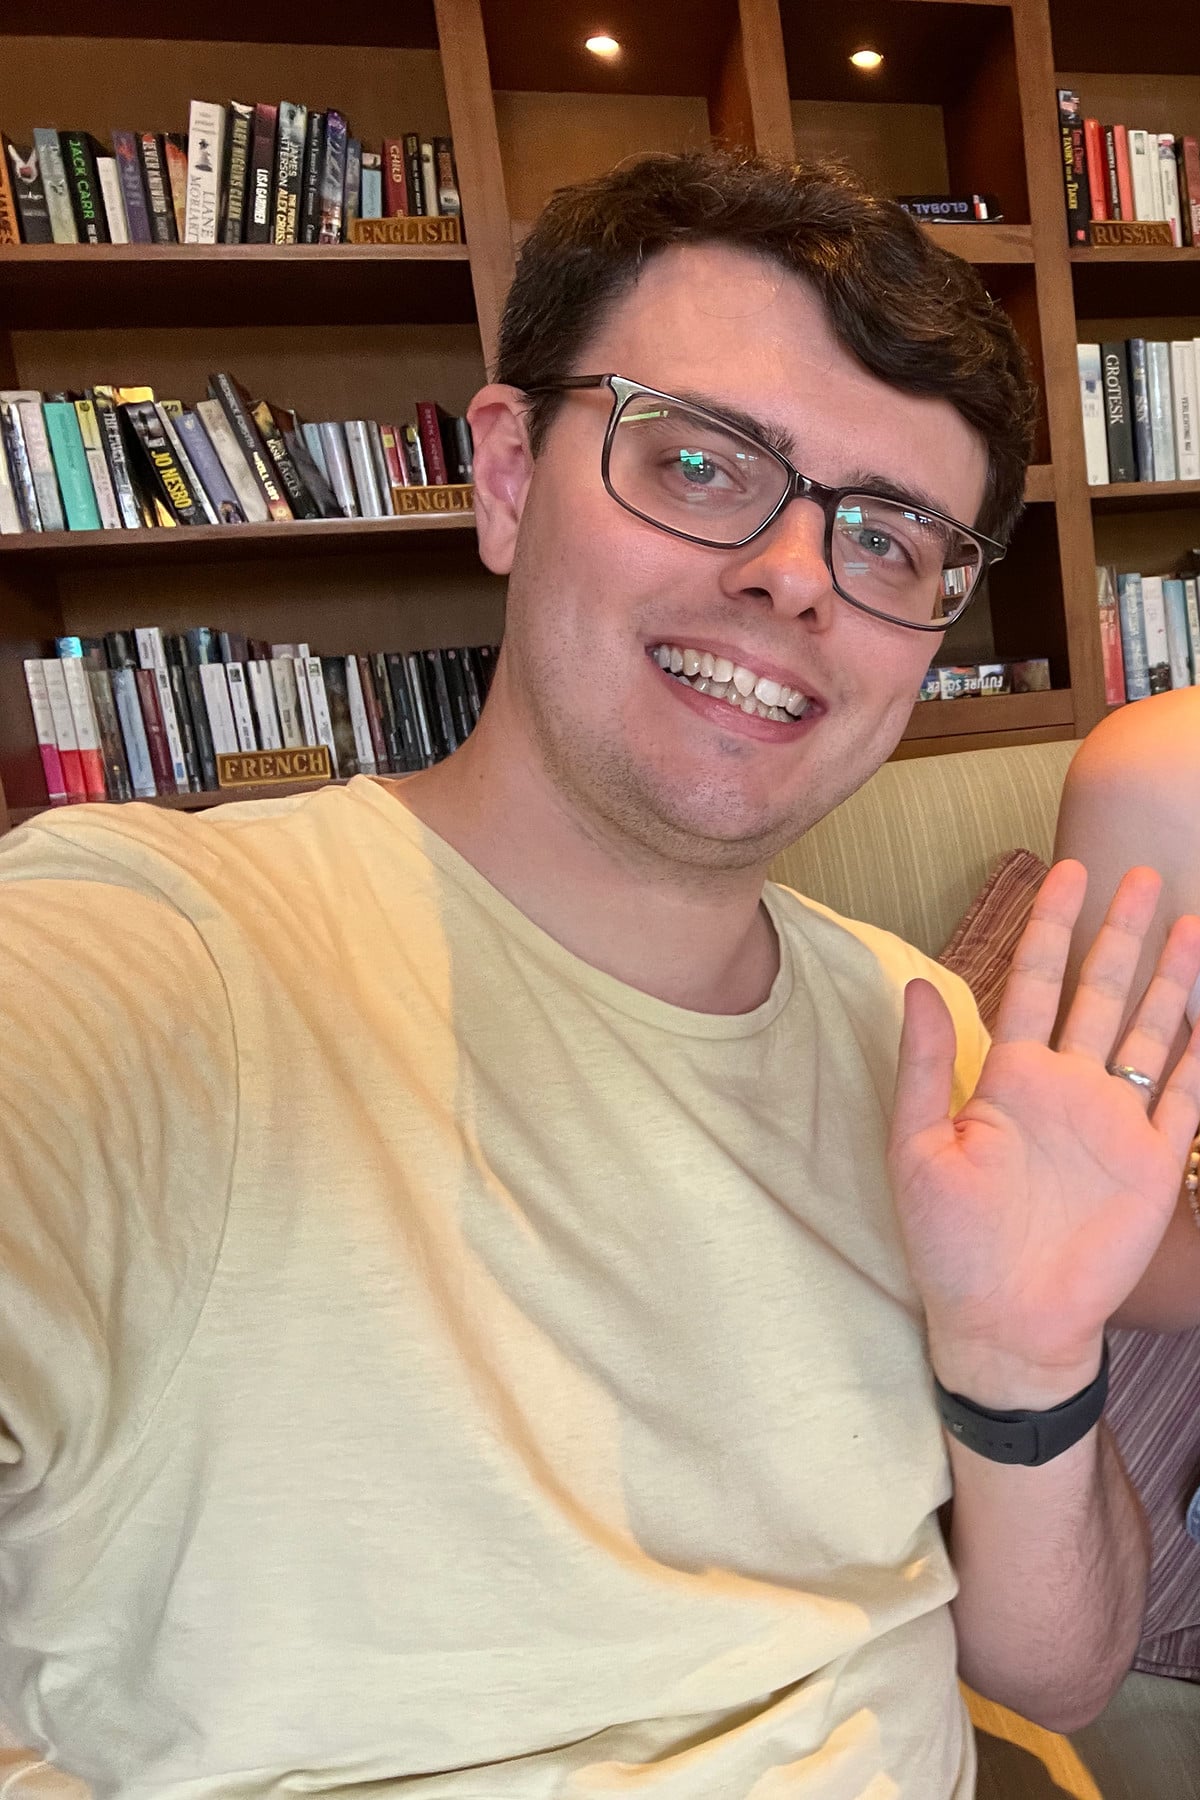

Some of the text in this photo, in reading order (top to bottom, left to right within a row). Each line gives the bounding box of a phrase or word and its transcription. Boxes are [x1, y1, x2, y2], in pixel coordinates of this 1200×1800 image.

[289, 141, 299, 177] JAMES
[390, 145, 402, 183] CHILD
[69, 139, 83, 177] JACK
[77, 180, 95, 220] CARR
[256, 168, 269, 188] LISA
[188, 174, 202, 243] MORIART
[276, 187, 289, 213] ALEX
[913, 202, 968, 214] GLOBAL
[201, 190, 216, 238] LIANE
[360, 221, 454, 243] ENGLISH
[1094, 225, 1172, 246] RUSSIAN
[1105, 354, 1124, 425] GROTESK
[151, 451, 173, 467] JO
[400, 489, 473, 512] ENGLI
[964, 675, 1004, 690] FUTURE
[225, 752, 324, 779] FRENCH
